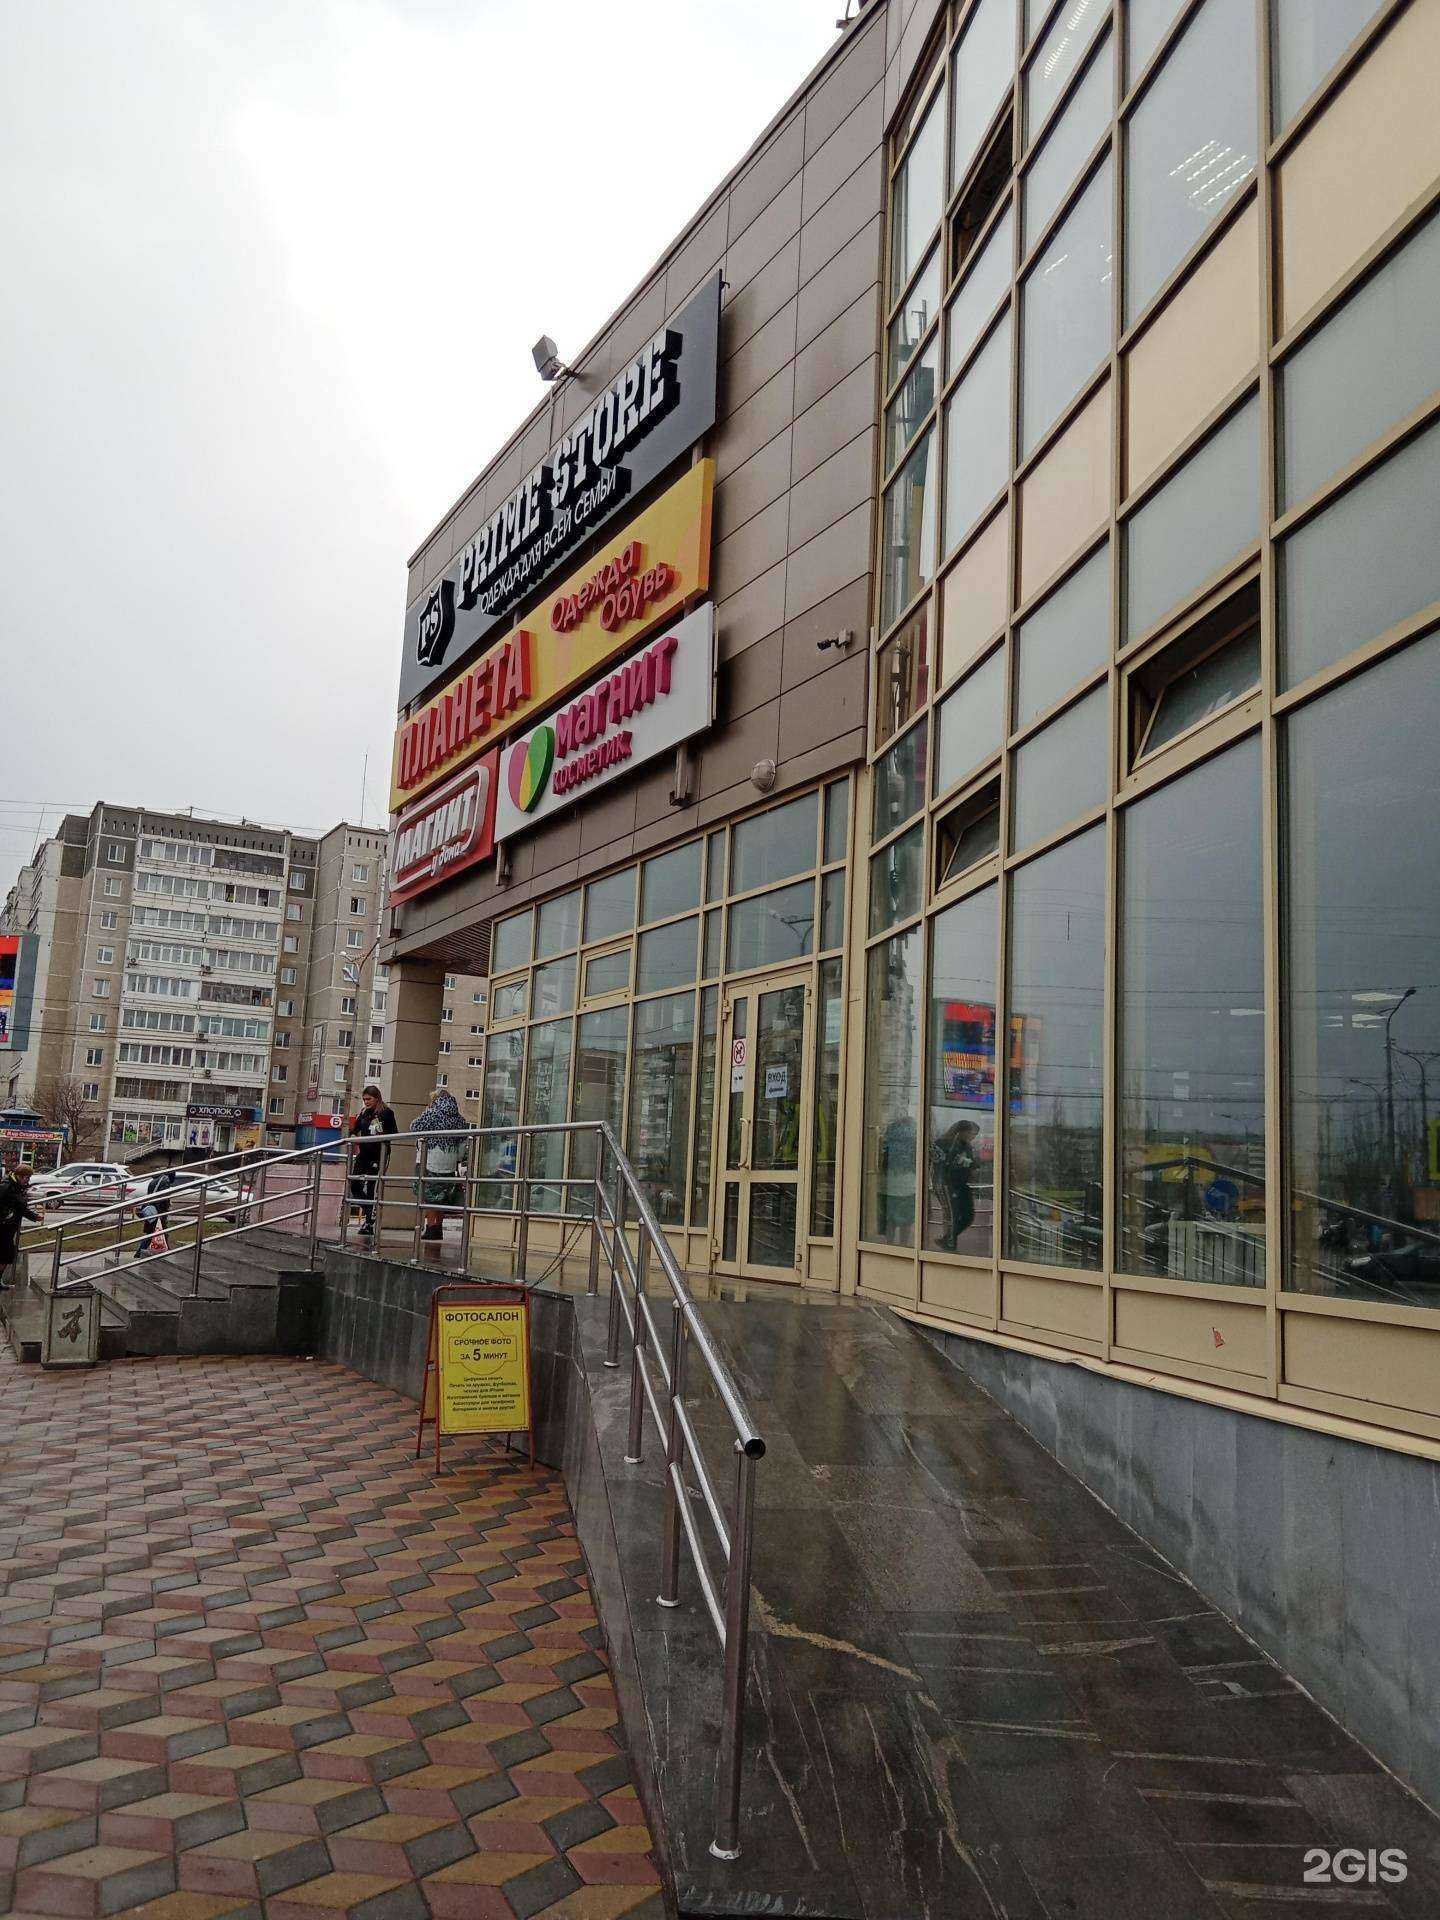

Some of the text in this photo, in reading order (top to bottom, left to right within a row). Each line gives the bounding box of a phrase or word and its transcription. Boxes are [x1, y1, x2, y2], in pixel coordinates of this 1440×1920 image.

[456, 330, 672, 602] PRIME STORE
[480, 465, 617, 615] ОДЕЖДА ДЛЯ ВСЕЙ СЕМЬИ
[551, 543, 637, 630] Одежда
[600, 563, 671, 630] Обувь
[420, 598, 441, 652] PS
[397, 630, 528, 789] ПЛАНЕТА
[394, 784, 478, 874] МАГНИТ
[199, 1106, 232, 1116] ХЛОПОК
[445, 1311, 519, 1322] ФОТОСАЛОН
[454, 1338, 490, 1346] СРОЧНОЕ
[473, 1348, 481, 1361] 5
[483, 1352, 508, 1360] МИНУТ
